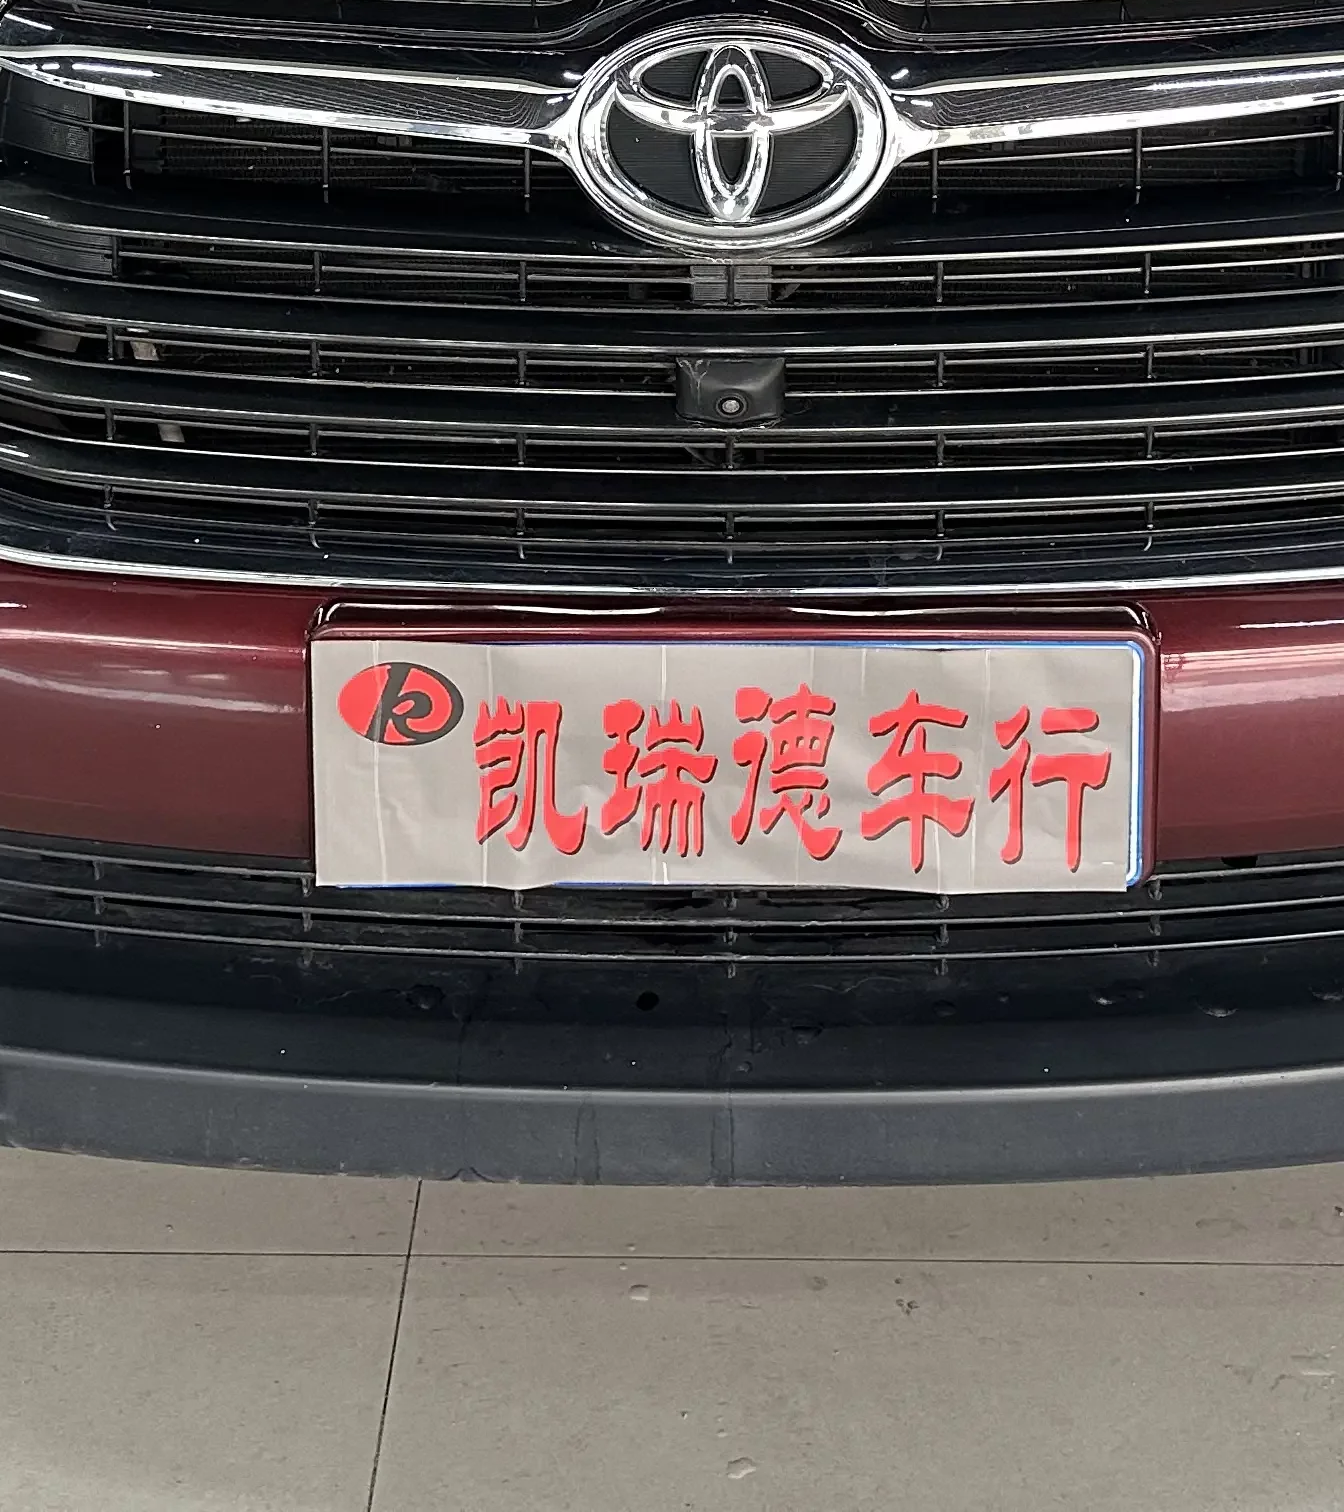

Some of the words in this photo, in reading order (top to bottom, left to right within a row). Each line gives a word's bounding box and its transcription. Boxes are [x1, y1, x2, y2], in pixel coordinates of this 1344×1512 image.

[472, 682, 1111, 873] 凯瑞德车行
